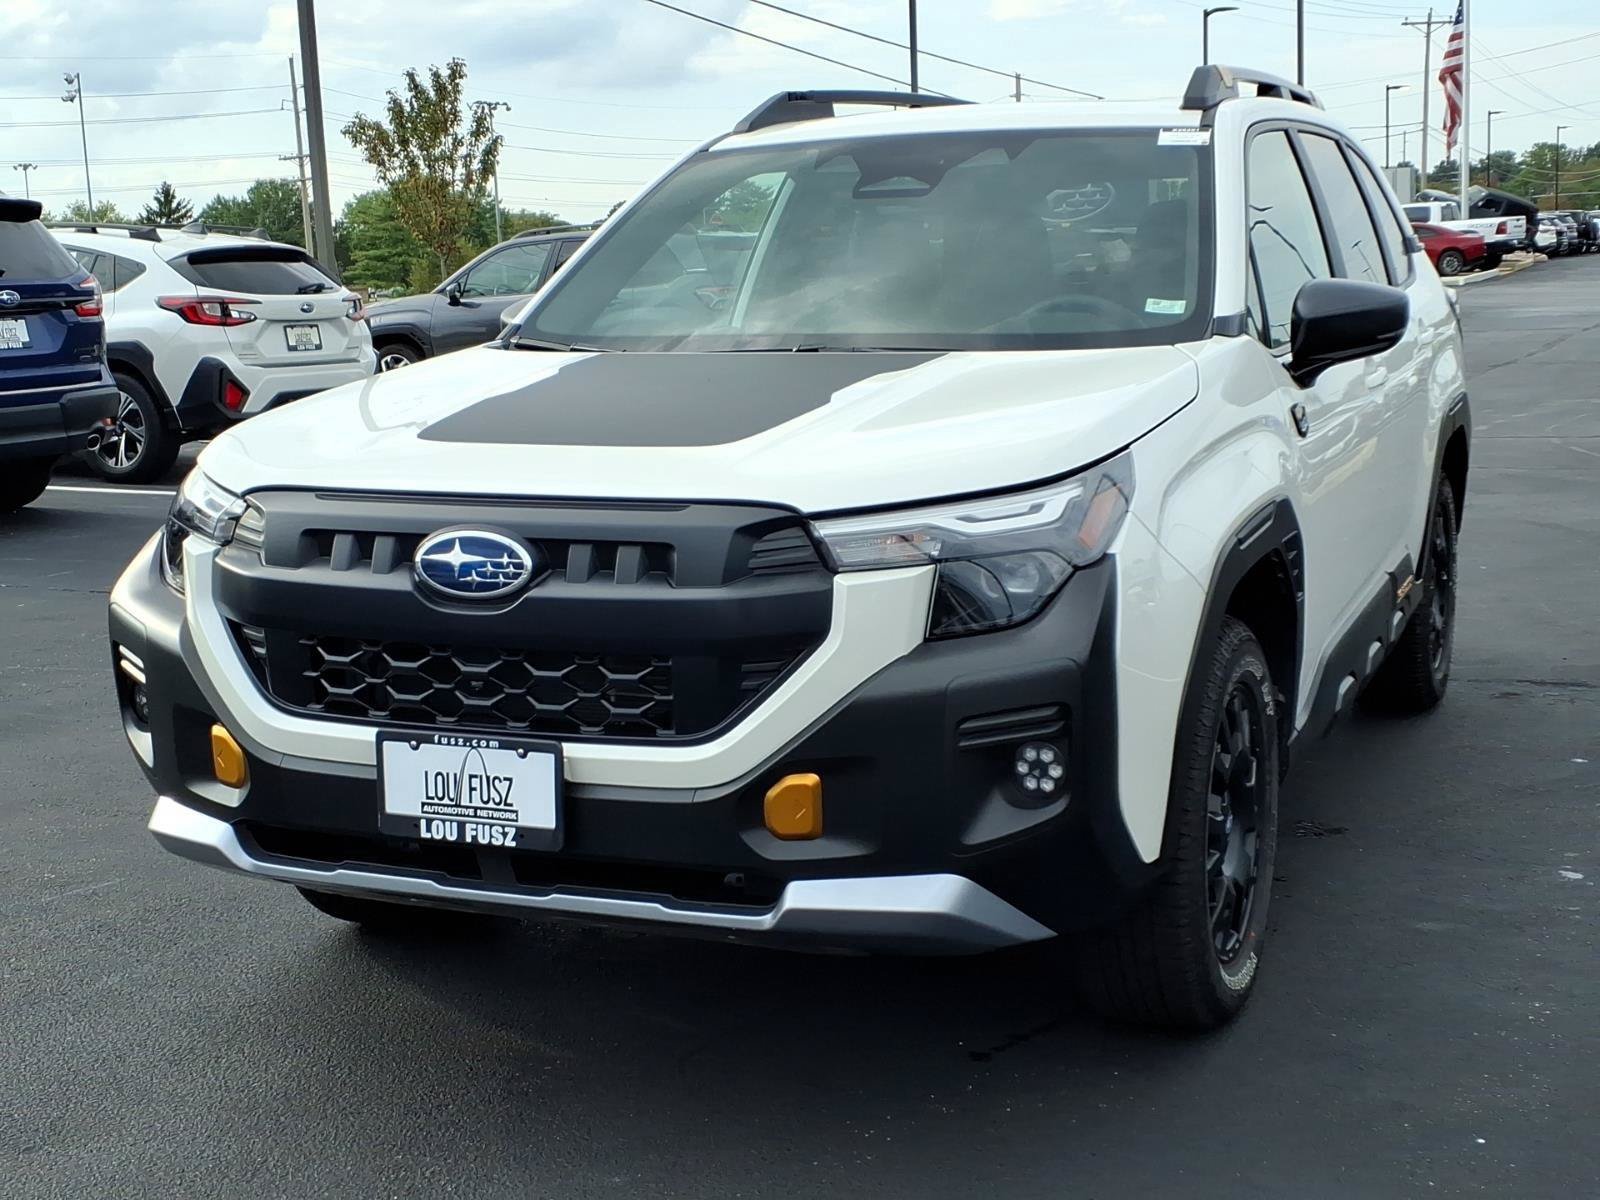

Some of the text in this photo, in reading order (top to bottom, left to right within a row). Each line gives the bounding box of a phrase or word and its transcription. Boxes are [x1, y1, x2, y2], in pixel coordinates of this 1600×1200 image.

[433, 734, 500, 749] fusz.com
[424, 770, 514, 807] LOU FUSZ
[422, 804, 517, 820] AUTOMOTIVE NETWORK
[420, 818, 517, 847] LOU FUSZ
